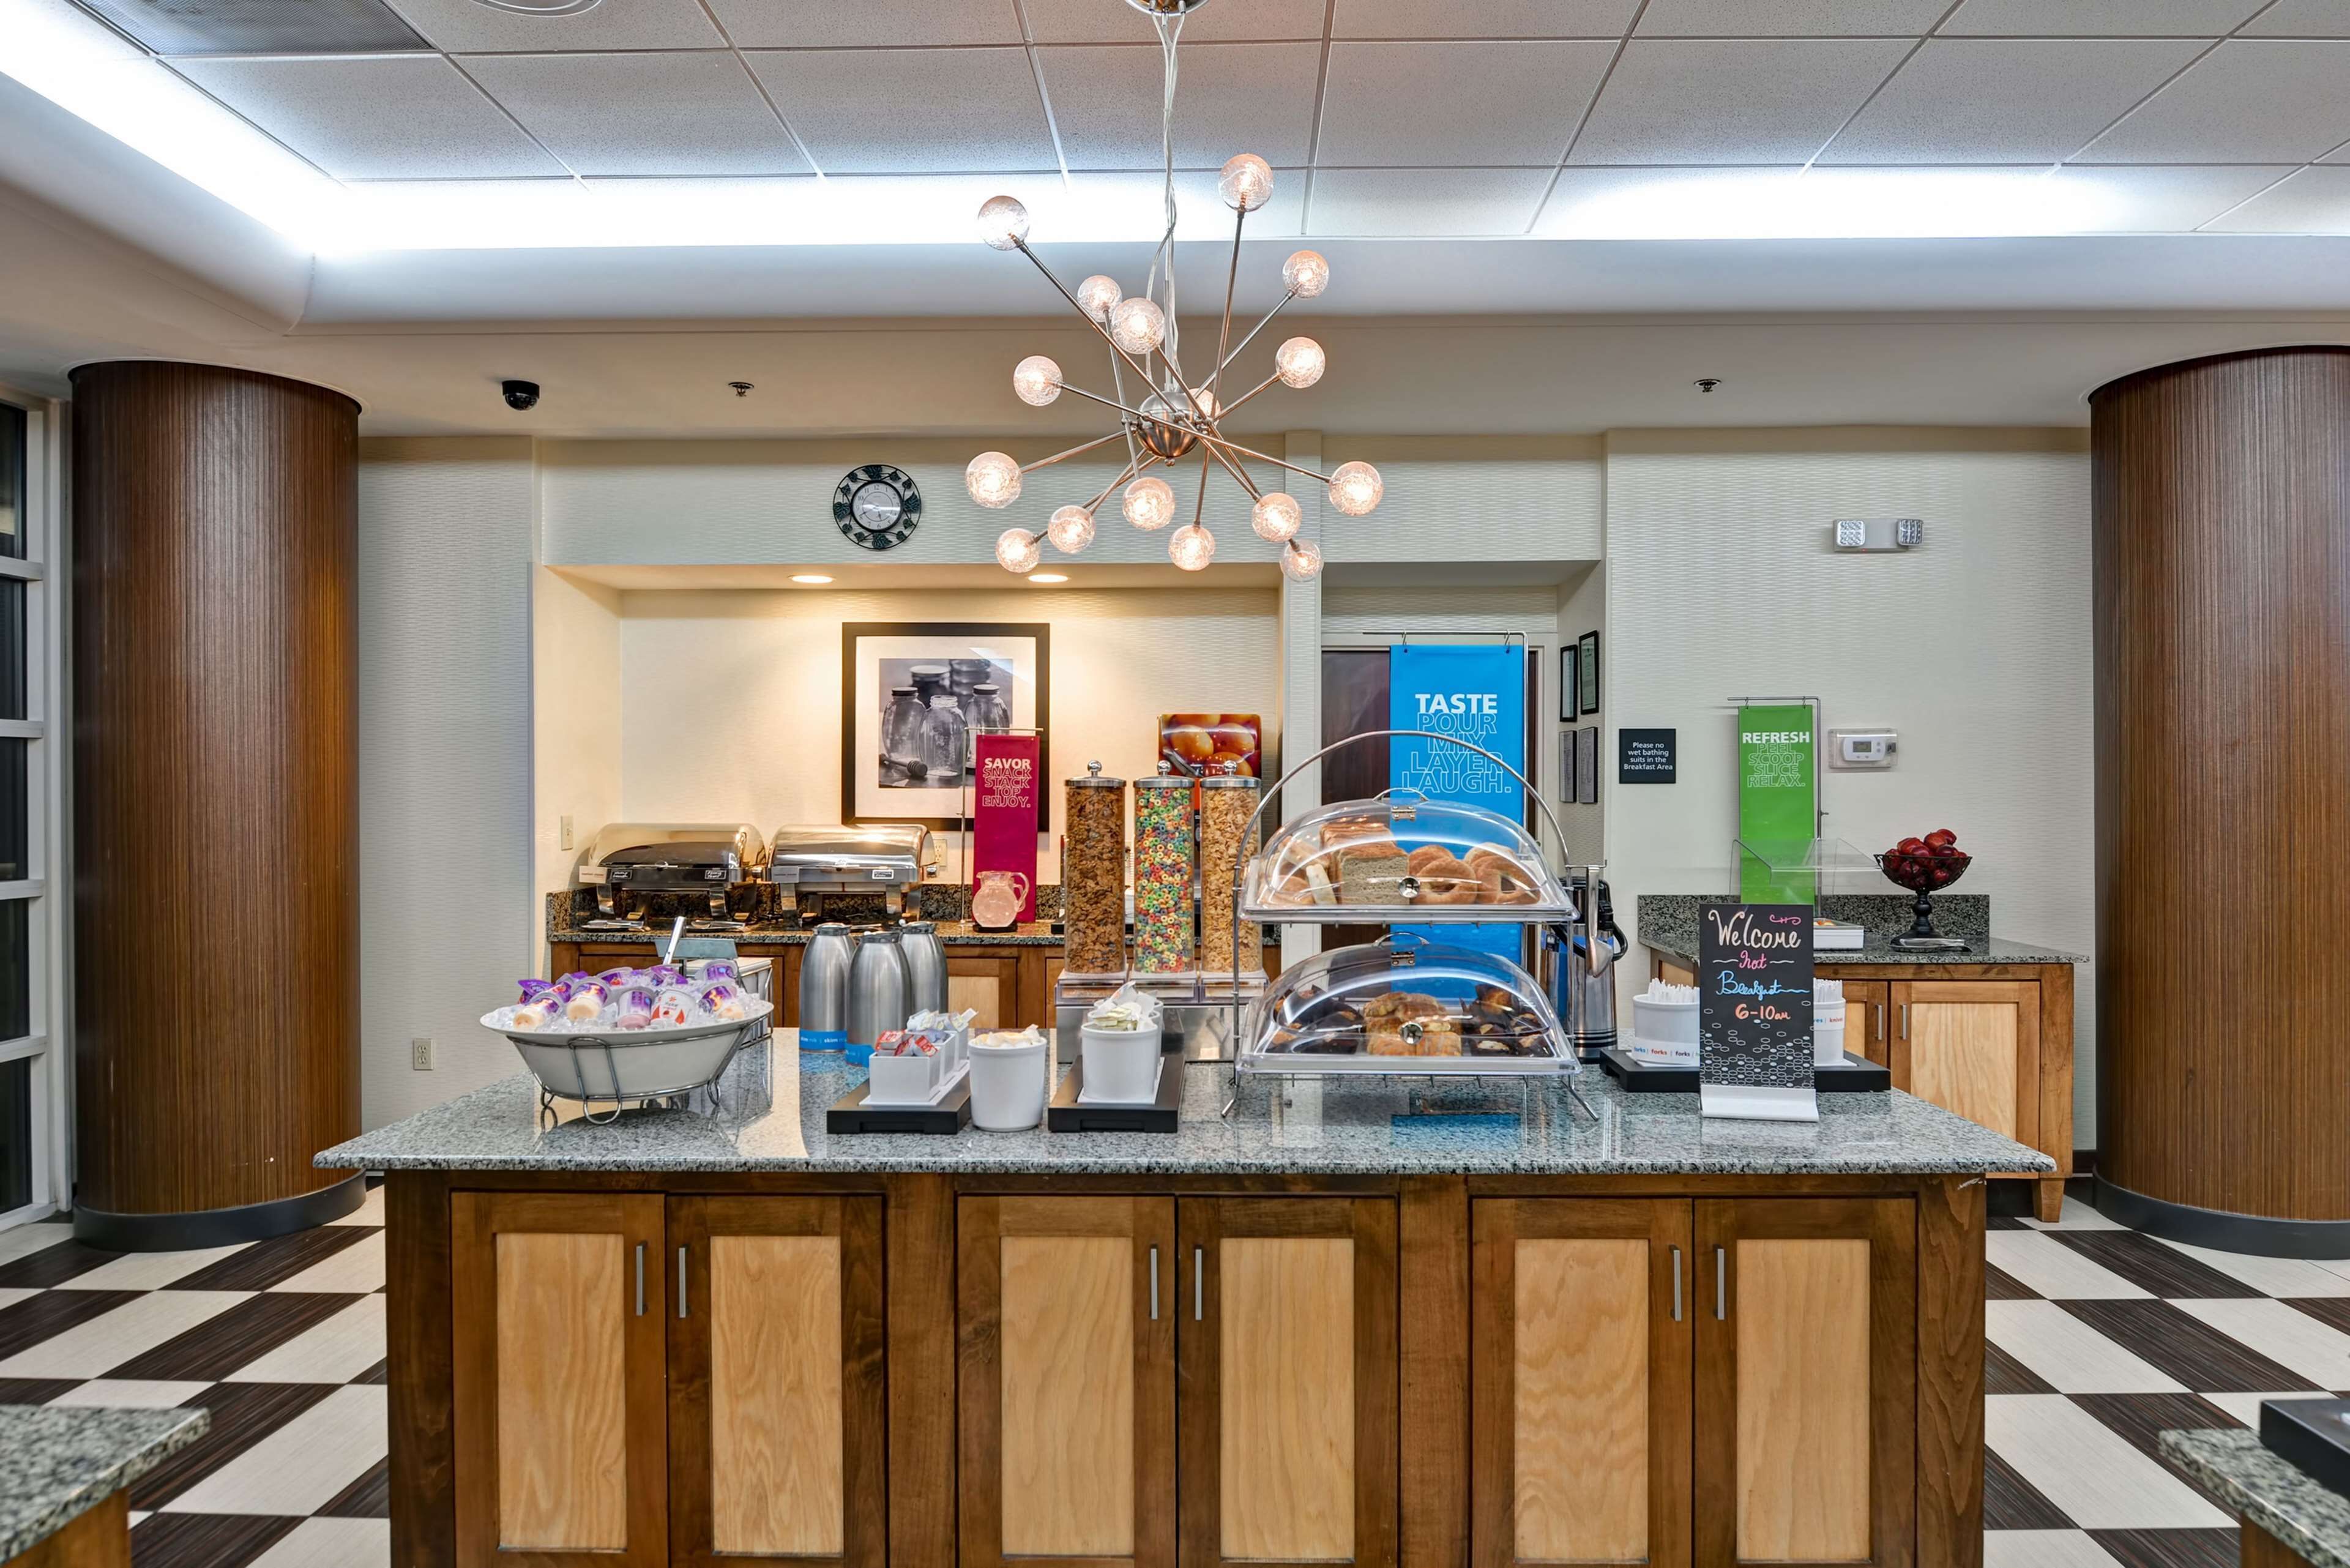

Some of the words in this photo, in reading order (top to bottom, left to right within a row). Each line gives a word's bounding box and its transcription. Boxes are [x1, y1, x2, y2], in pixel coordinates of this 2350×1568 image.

[1415, 694, 1498, 714] TASTE
[1417, 712, 1497, 733] POUR
[1428, 732, 1486, 753] MIX
[1742, 731, 1810, 744] REFRESH
[1757, 742, 1796, 753] PEEL
[985, 758, 1031, 769] SAVOR
[1411, 752, 1503, 773] LAYER
[1748, 753, 1804, 765] SCOOP
[983, 767, 1032, 778] SNACK
[1754, 764, 1798, 776] SLICE
[985, 777, 1029, 788] STACK
[1402, 772, 1511, 793] LAUGH.
[1747, 775, 1805, 787] RELAX.
[993, 787, 1021, 797] TOP
[982, 796, 1031, 808] ENJOY.
[1708, 909, 1801, 948] Welcome
[1739, 950, 1767, 969] hot
